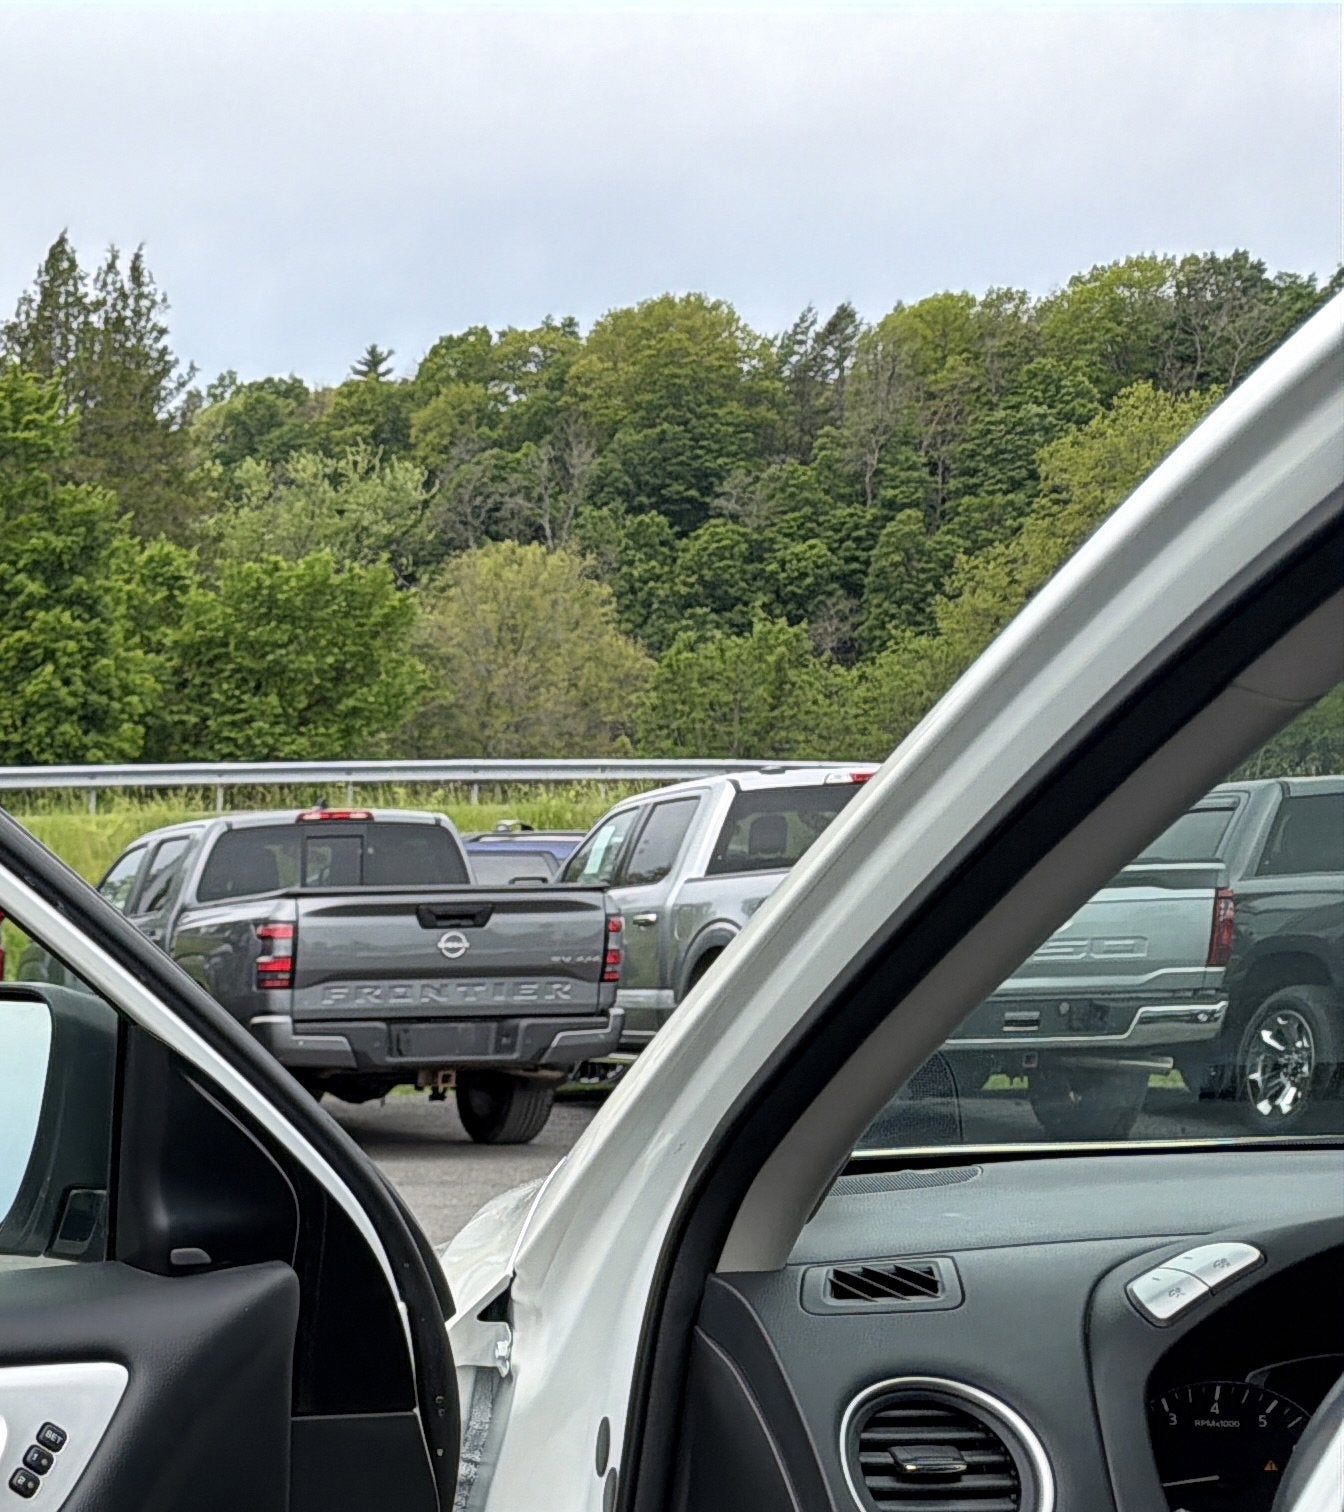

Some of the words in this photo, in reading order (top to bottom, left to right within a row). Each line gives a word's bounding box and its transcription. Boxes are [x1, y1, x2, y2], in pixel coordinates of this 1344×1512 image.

[320, 981, 572, 1005] FRONTIER
[1209, 1402, 1220, 1415] 4
[1168, 1412, 1178, 1426] 3
[1257, 1414, 1268, 1428] 5
[44, 1429, 64, 1444] SET
